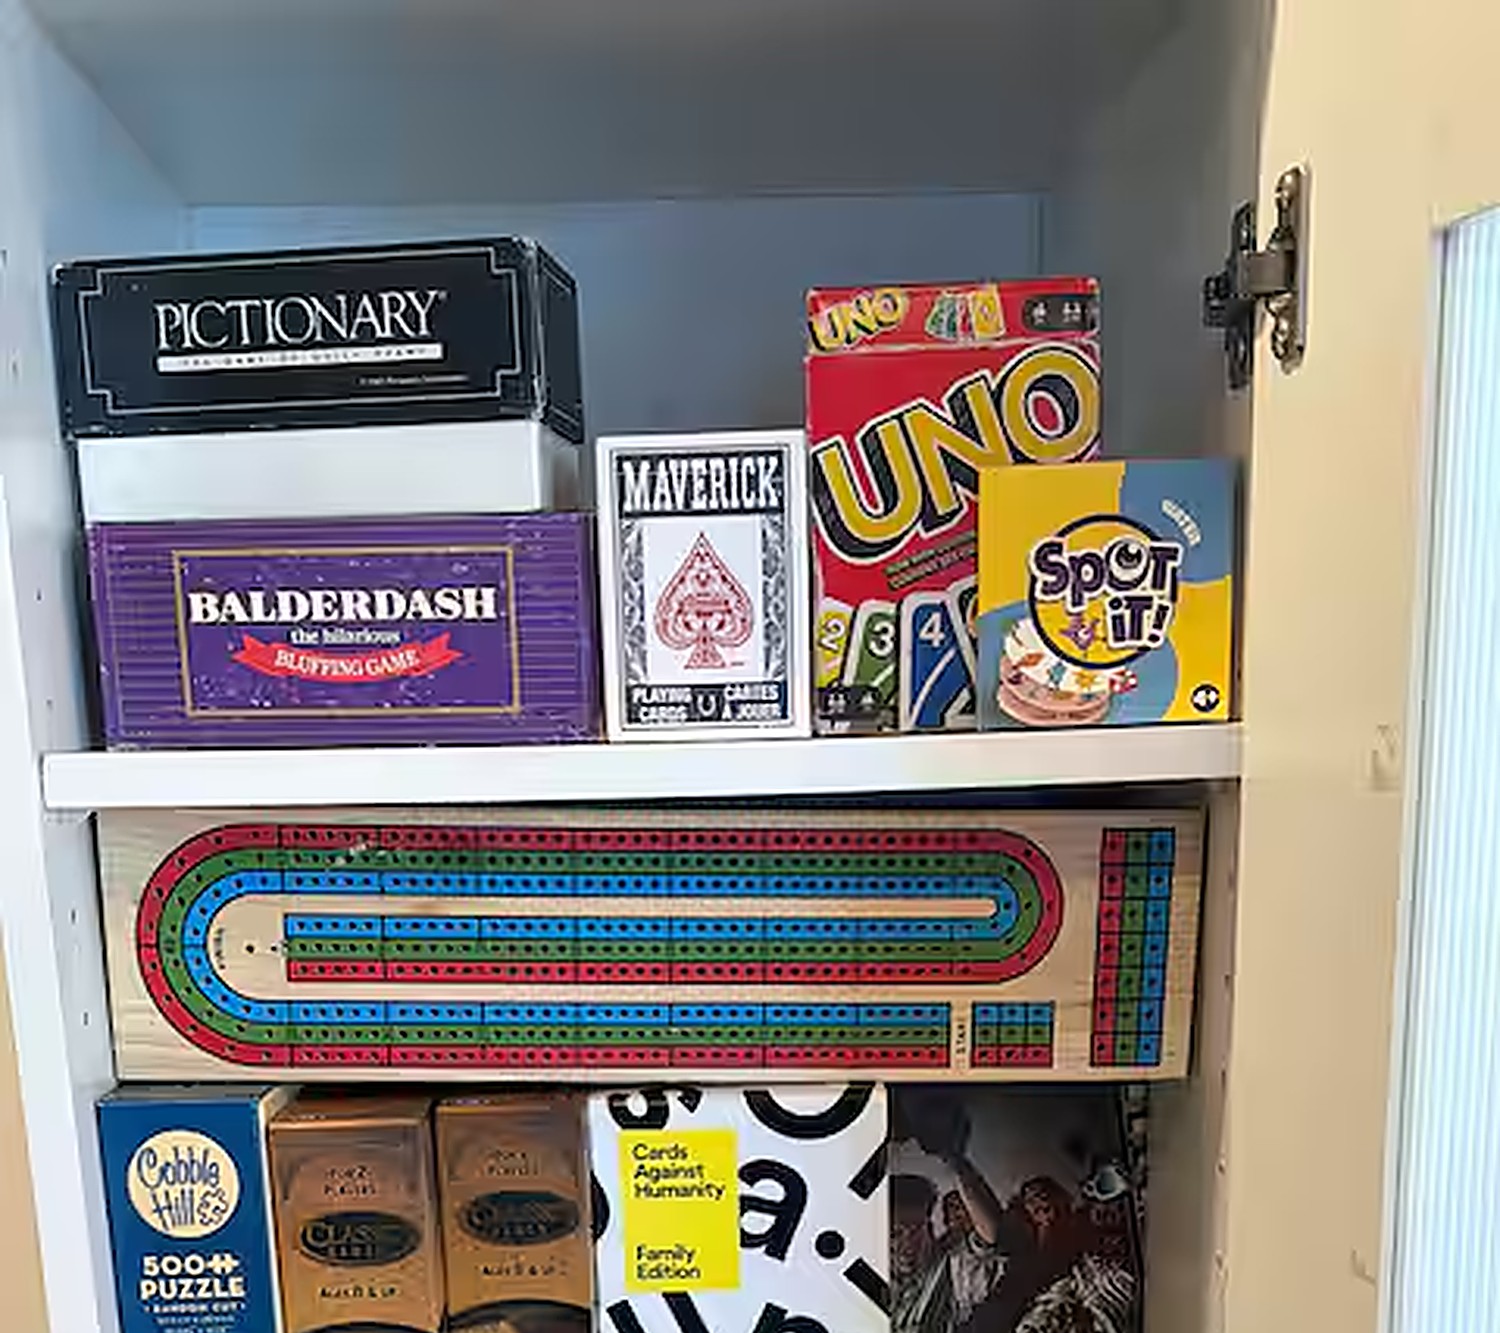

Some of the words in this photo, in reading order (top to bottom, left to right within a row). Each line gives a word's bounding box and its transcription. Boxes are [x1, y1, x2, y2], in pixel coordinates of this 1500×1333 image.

[154, 290, 437, 350] PICTIONARY
[809, 287, 905, 352] UNO
[812, 348, 1098, 555] UNO
[622, 455, 779, 513] MAVERICK
[188, 586, 497, 624] BALDERDASH
[290, 627, 319, 644] the
[322, 627, 401, 645] hilarious
[869, 622, 896, 656] 3
[919, 612, 945, 648] 4
[274, 649, 364, 676] BLUFFING
[364, 648, 420, 676] GAME
[632, 687, 692, 704] PLAYING
[632, 1143, 688, 1161] Cards
[136, 1146, 220, 1190] Cobble
[633, 1163, 704, 1185] Against
[633, 1182, 726, 1201] Humanity
[152, 1188, 195, 1232] Hill
[143, 1255, 205, 1277] 500
[636, 1244, 696, 1264] Family
[637, 1263, 702, 1281] Edition
[141, 1277, 246, 1300] PUZZLE
